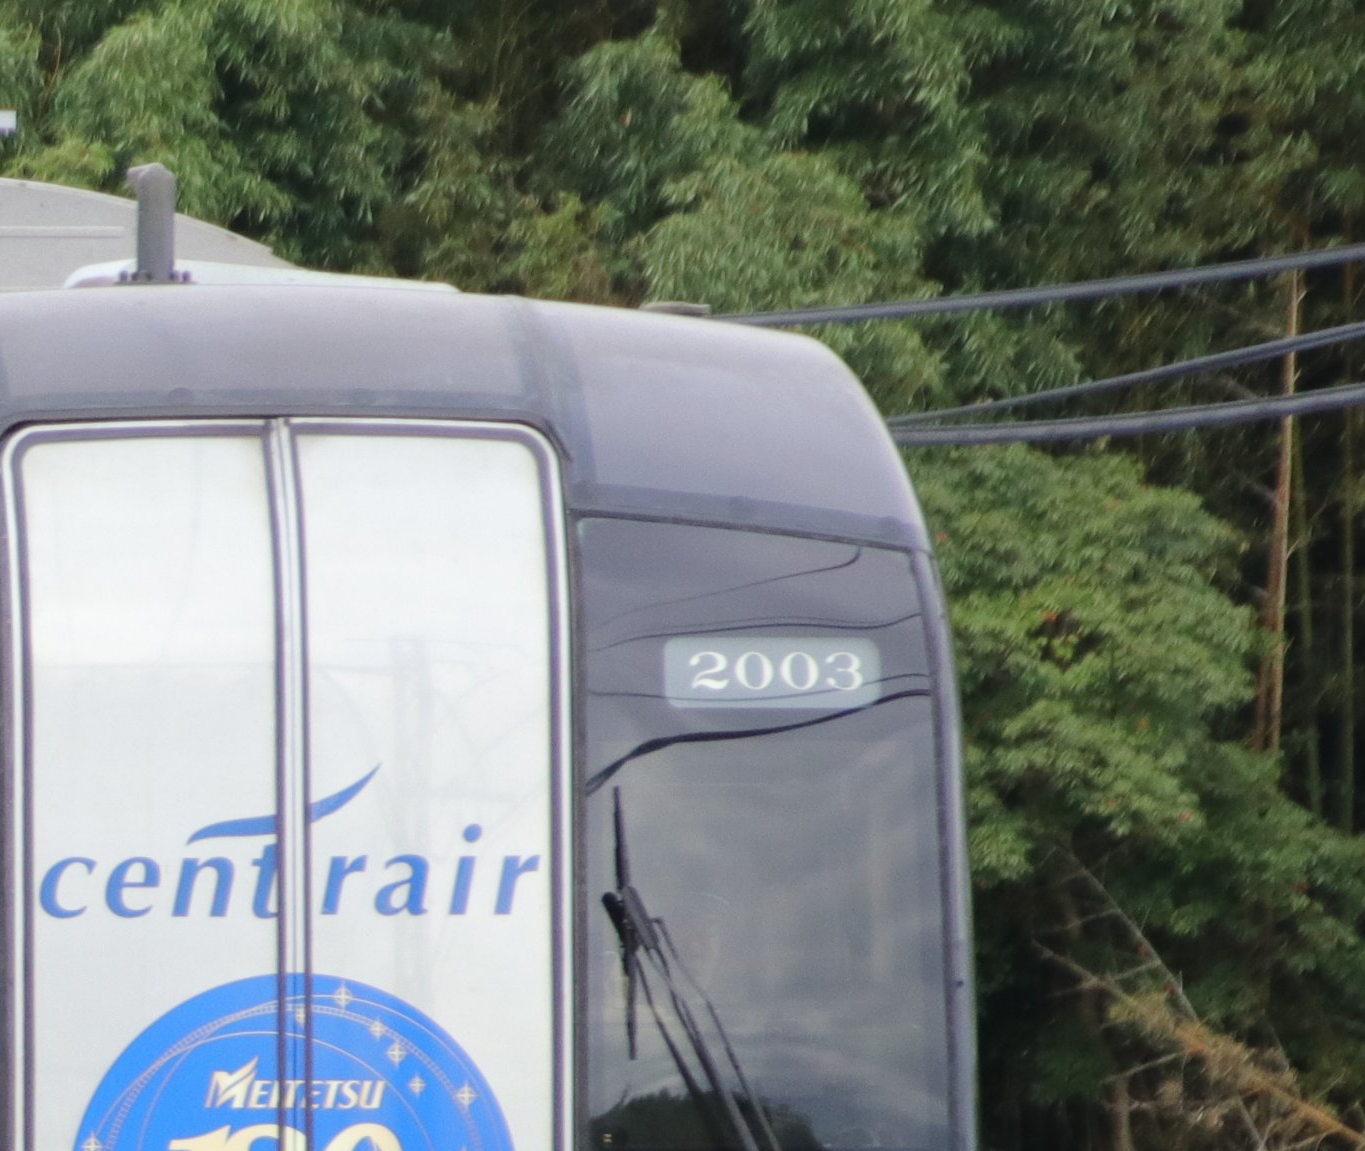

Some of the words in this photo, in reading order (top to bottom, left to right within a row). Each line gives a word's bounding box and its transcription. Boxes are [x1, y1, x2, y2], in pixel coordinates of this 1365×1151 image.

[688, 651, 864, 690] 2003
[38, 788, 541, 919] centrair
[204, 1056, 385, 1109] MEITETSU
